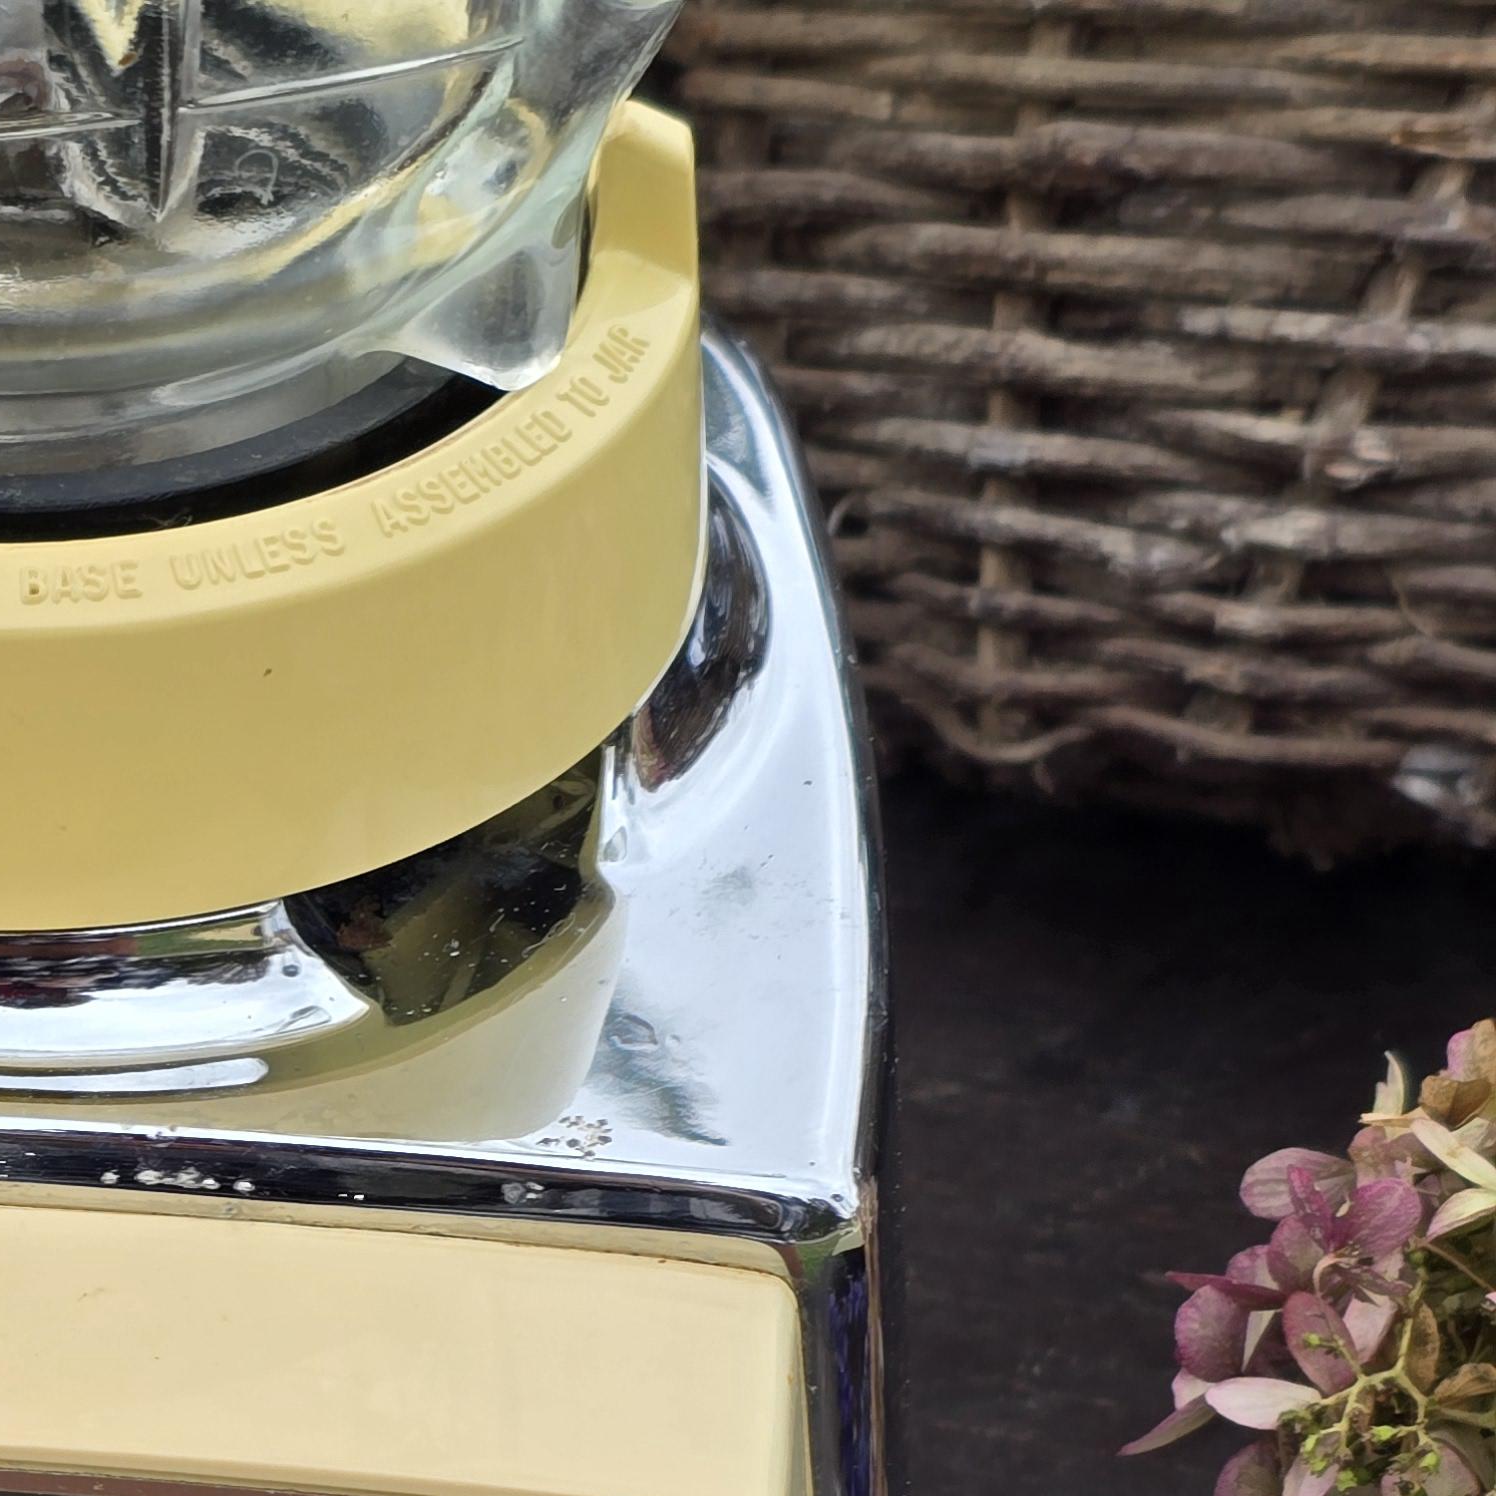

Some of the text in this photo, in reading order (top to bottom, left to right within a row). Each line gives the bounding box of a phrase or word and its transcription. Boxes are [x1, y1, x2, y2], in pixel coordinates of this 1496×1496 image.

[18, 560, 144, 606] BASE
[169, 517, 346, 590] UNLESS
[370, 408, 573, 538] ASSEMBLED
[555, 376, 610, 418] TO
[591, 323, 651, 384] JAR
